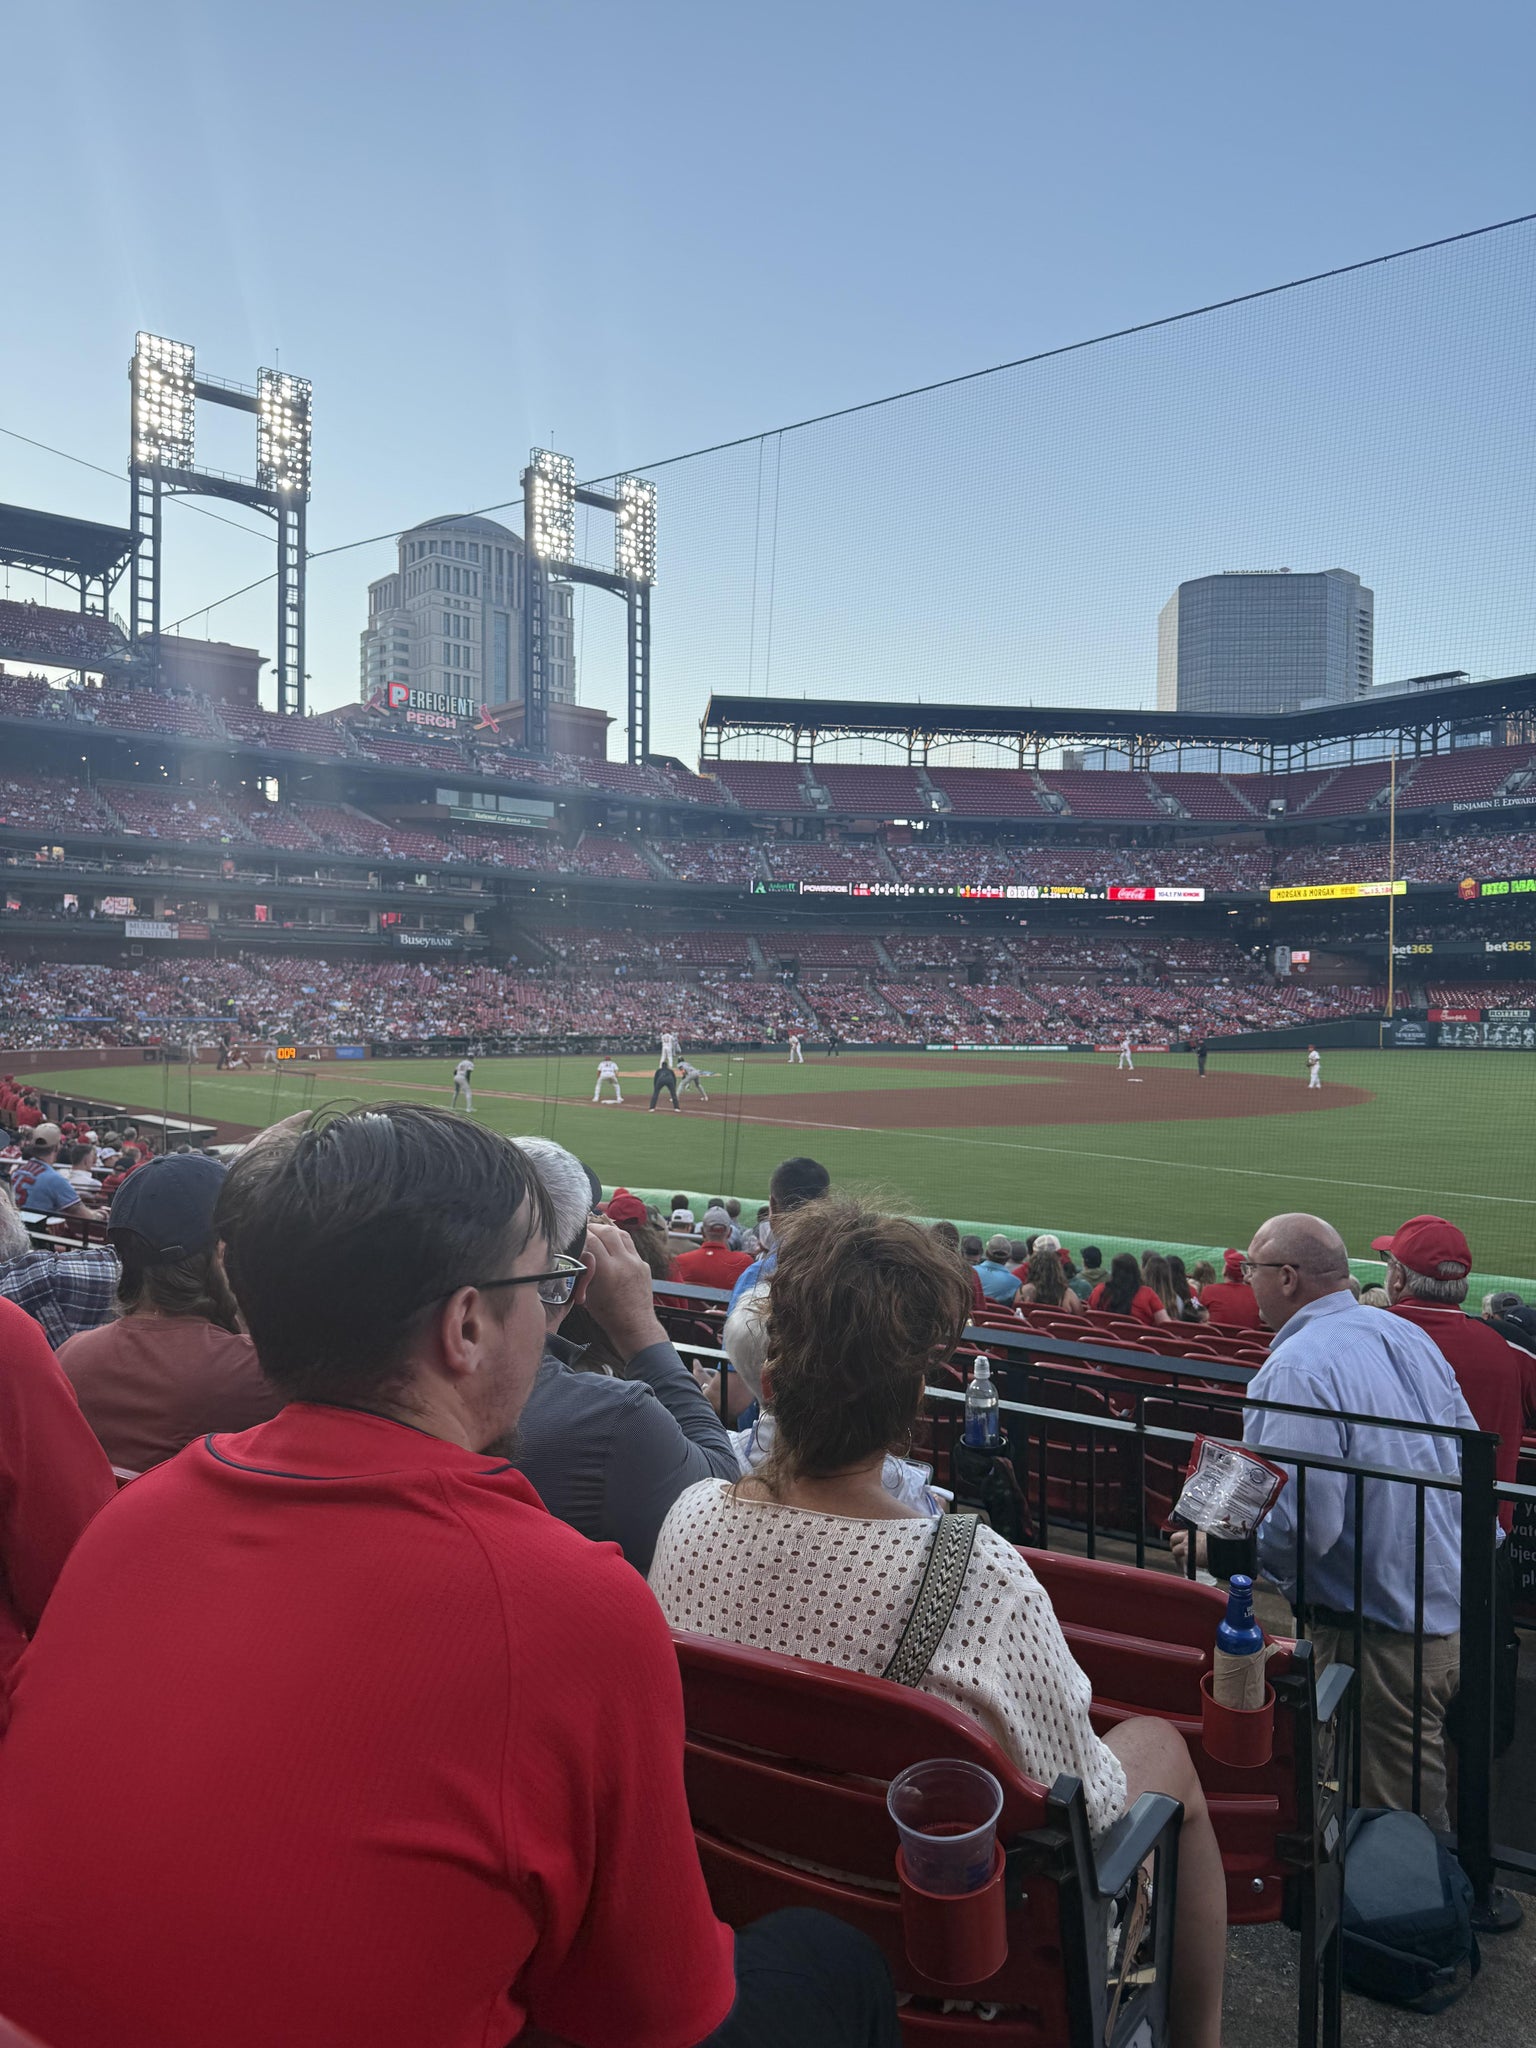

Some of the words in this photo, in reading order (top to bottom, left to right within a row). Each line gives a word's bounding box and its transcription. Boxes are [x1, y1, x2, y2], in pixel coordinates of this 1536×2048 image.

[388, 681, 475, 717] PERFICIENT
[406, 710, 457, 729] PERCH
[1453, 800, 1493, 811] BENJAMIN
[803, 884, 849, 894] POWERADE
[1276, 891, 1302, 899] MORGAN
[1309, 887, 1335, 896] MORGAN
[1392, 944, 1434, 955] bet365
[1485, 941, 1531, 952] bet365
